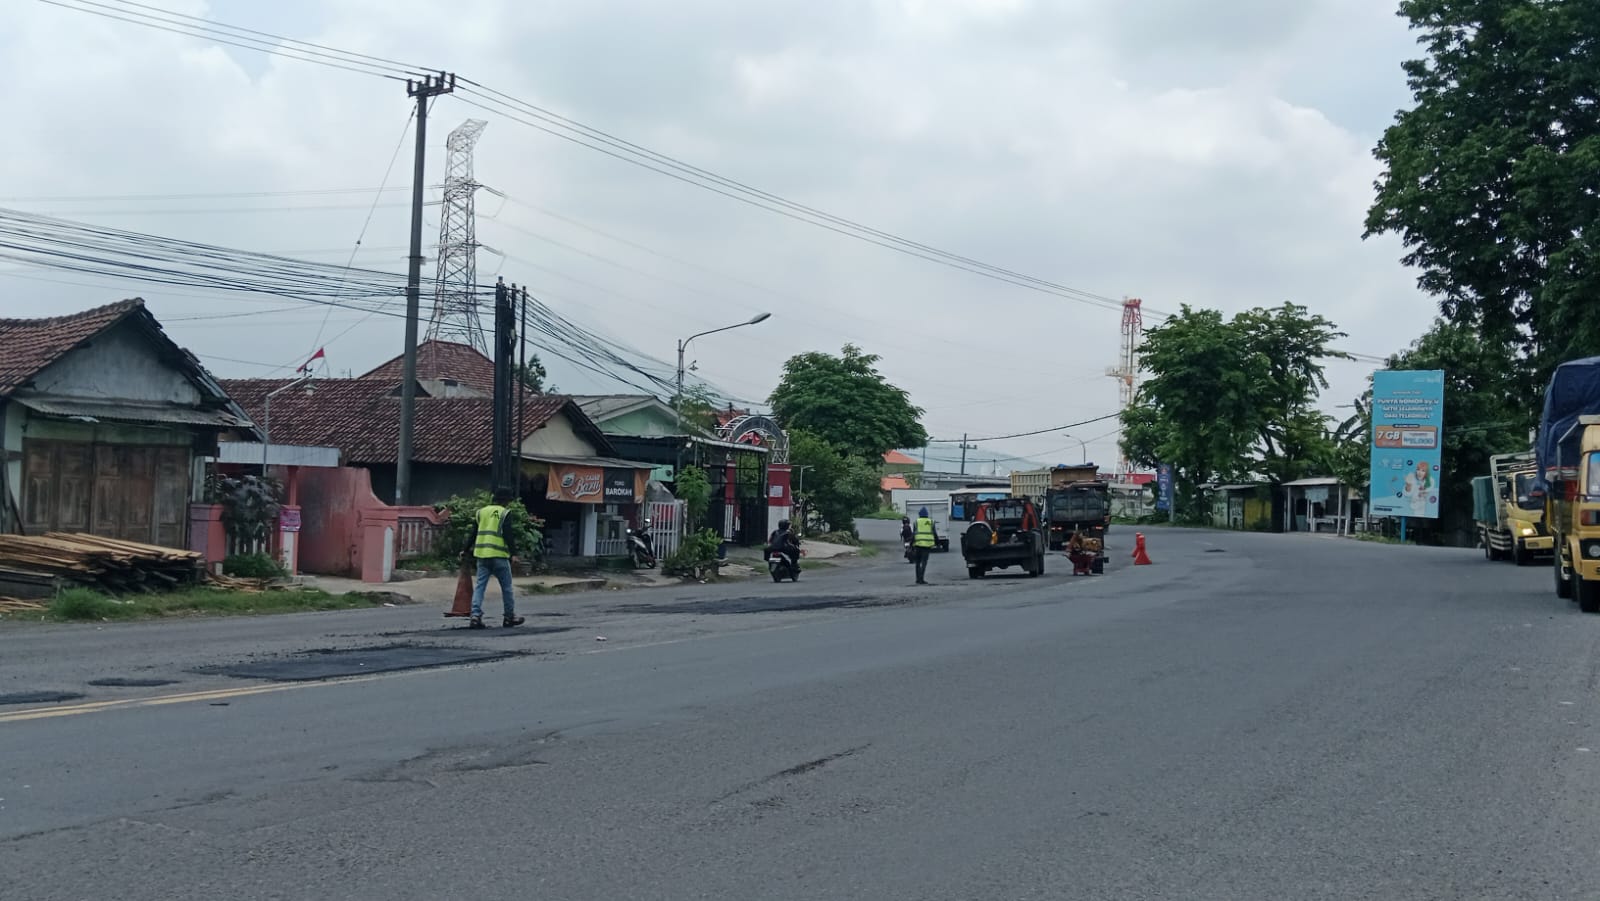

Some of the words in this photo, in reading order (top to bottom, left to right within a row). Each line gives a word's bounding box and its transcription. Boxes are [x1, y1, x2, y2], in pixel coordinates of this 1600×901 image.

[1377, 431, 1384, 439] 7
[1385, 431, 1400, 440] GB
[605, 487, 632, 496] BAROKAH
